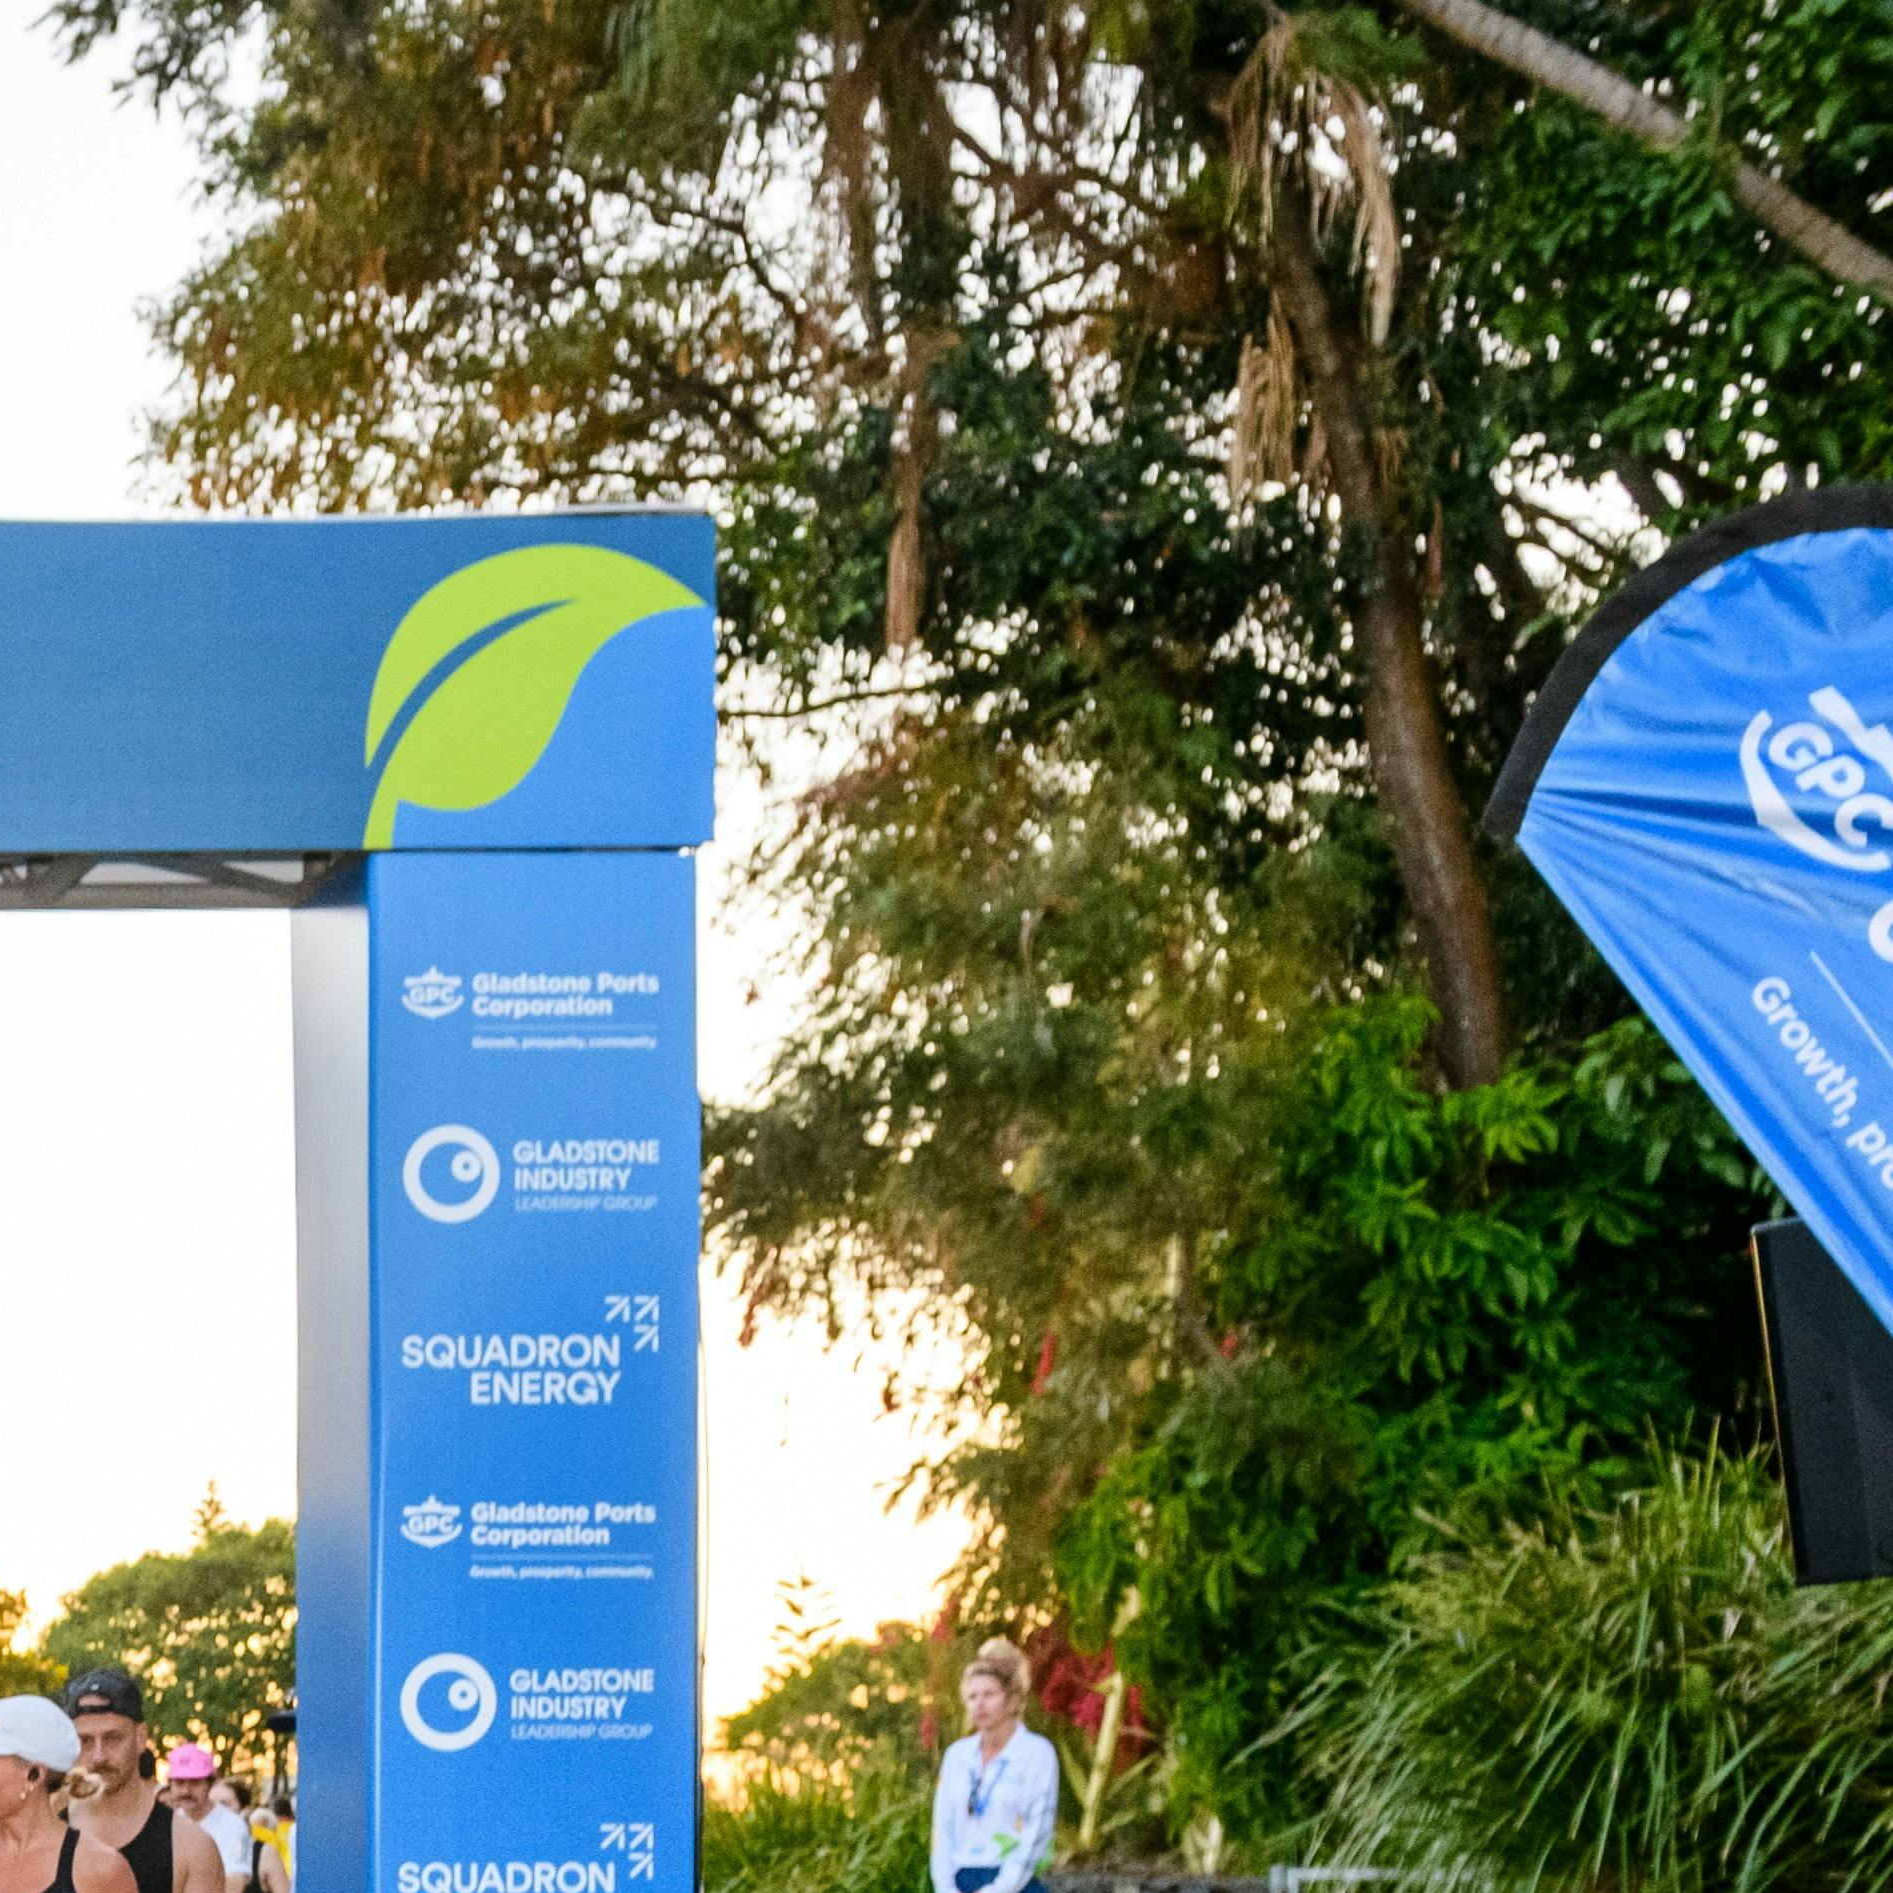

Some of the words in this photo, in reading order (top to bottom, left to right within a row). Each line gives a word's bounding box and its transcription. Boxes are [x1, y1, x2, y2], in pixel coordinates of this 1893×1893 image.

[1768, 720, 1893, 848] GPC
[471, 971, 592, 994] Gladstone
[597, 970, 661, 994] Ports
[471, 994, 614, 1019] Corporation
[1751, 975, 1860, 1128] Growth,
[513, 1139, 660, 1166] GLADSTONE
[514, 1166, 632, 1191] INDUSTRY
[401, 1333, 621, 1369] SQUADRON
[470, 1370, 621, 1405] ENERGY
[408, 1515, 454, 1534] GPC
[470, 1501, 590, 1524] Gladstone
[594, 1500, 657, 1523] Ports
[470, 1523, 611, 1549] Corporation
[510, 1668, 655, 1694] GLADSTONE
[510, 1695, 627, 1721] INDUSTRY
